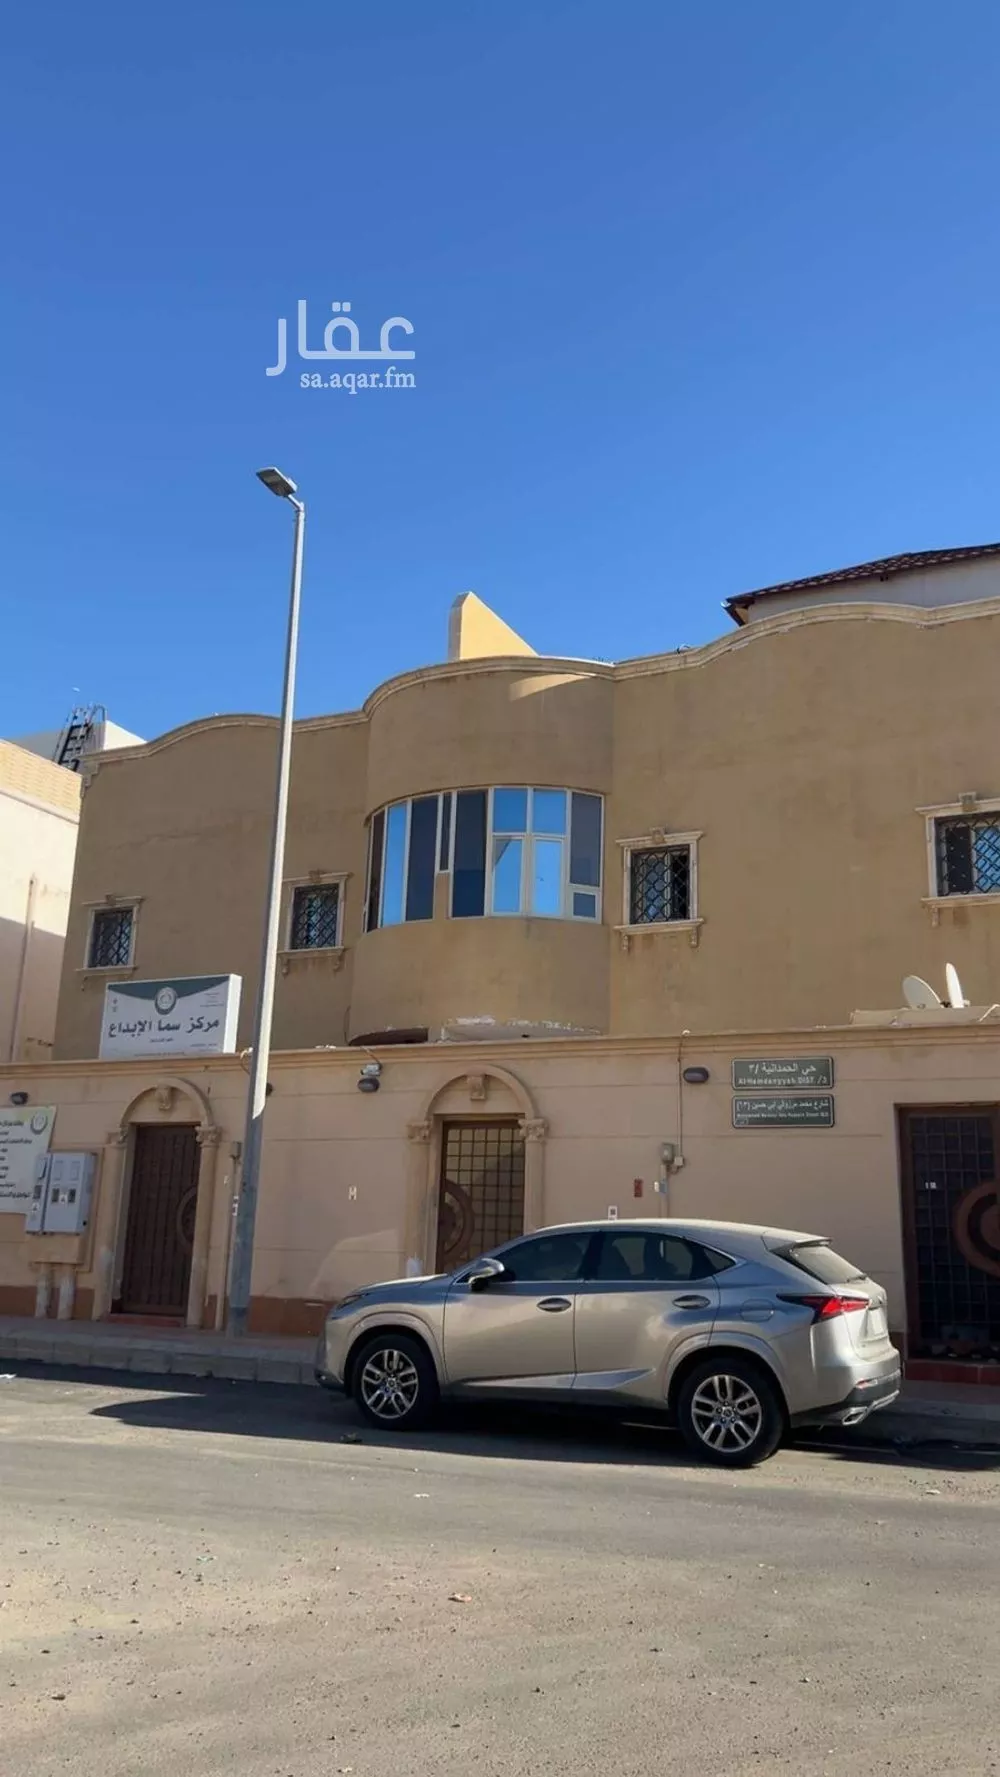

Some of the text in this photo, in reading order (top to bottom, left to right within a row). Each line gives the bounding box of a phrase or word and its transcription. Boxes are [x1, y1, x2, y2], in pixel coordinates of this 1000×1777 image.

[108, 1016, 220, 1038] مركز سما الإبداع
[801, 1064, 817, 1075] حي
